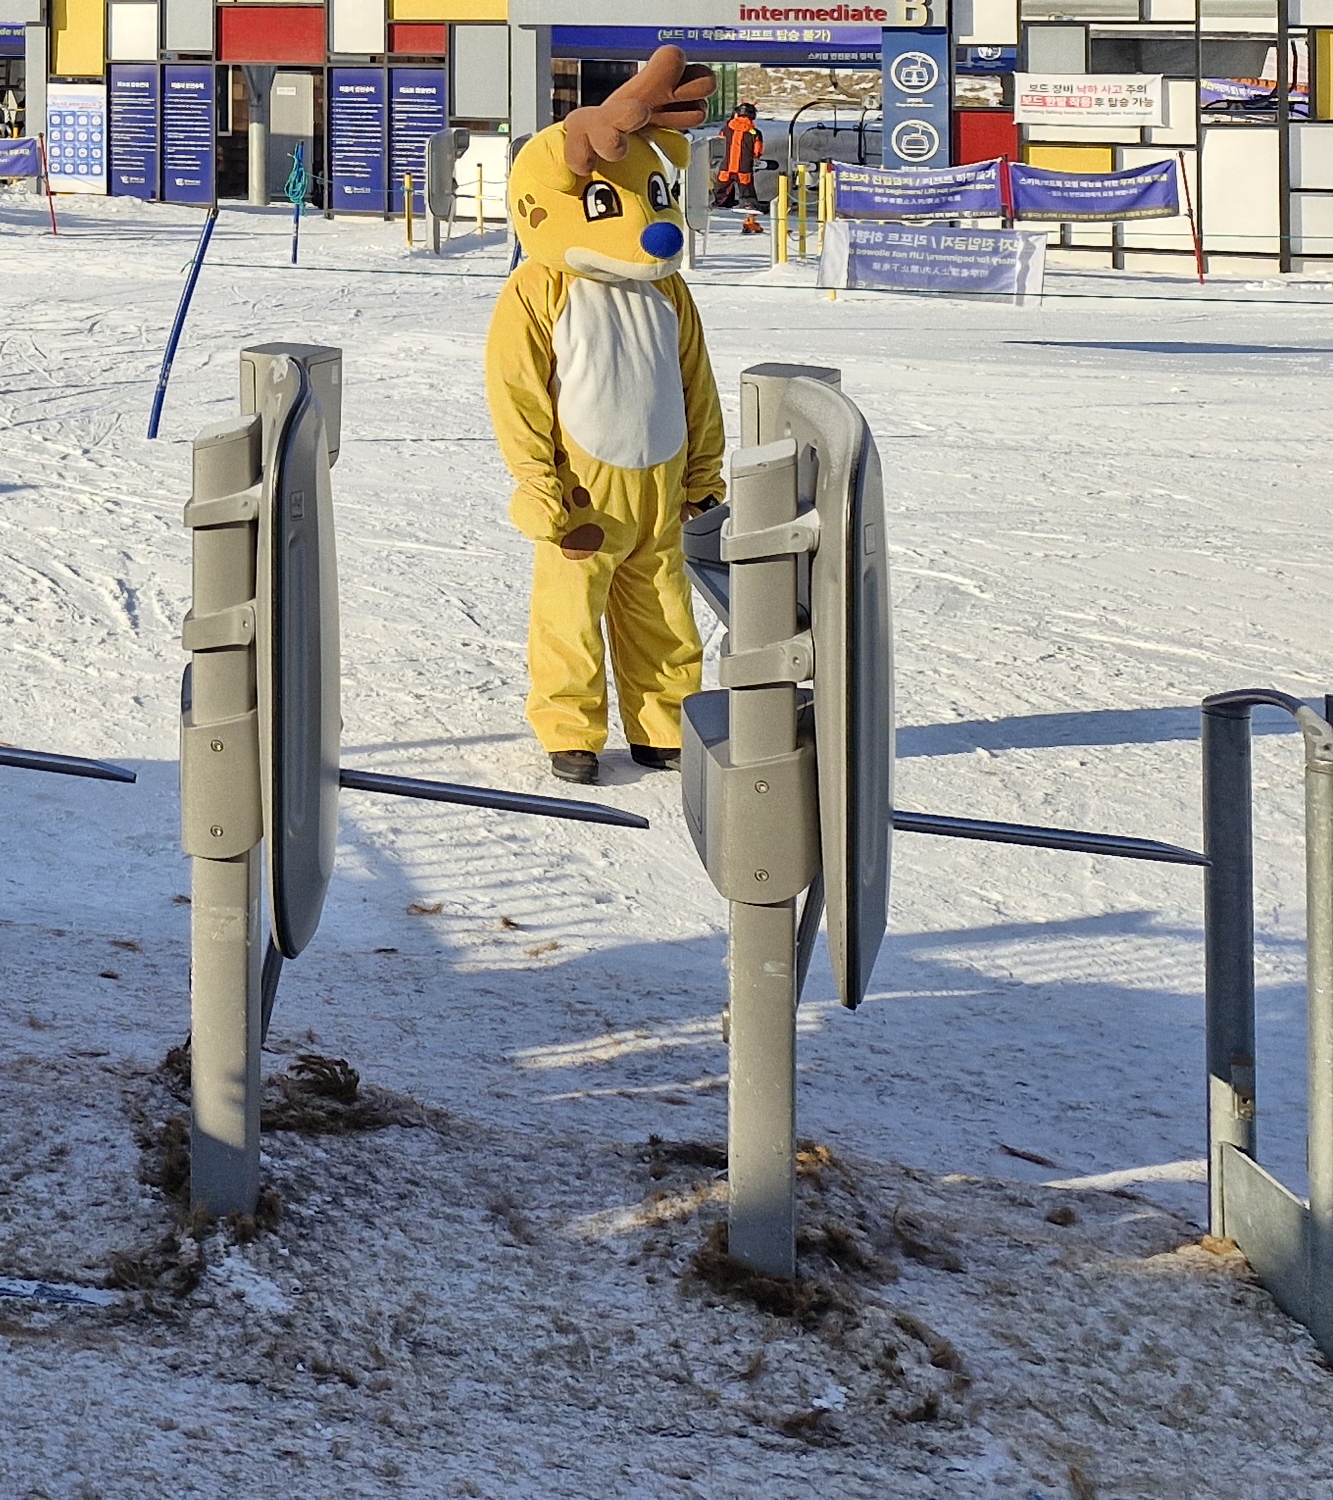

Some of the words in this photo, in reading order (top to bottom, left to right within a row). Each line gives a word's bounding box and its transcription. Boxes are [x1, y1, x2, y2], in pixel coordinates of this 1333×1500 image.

[740, 4, 887, 22] intermediate
[13, 28, 26, 36] wi
[738, 29, 774, 41] 리프트
[777, 29, 799, 41] 탑승
[1029, 83, 1050, 93] 보드
[1052, 84, 1074, 94] 장비
[1076, 84, 1098, 94] 낙하
[1100, 85, 1124, 94] 사고
[1125, 84, 1148, 94] 주의
[1108, 98, 1129, 107] 탑승
[1132, 97, 1154, 107] 가능
[839, 170, 870, 184] 초보자
[872, 174, 913, 186] 진입금지
[922, 175, 955, 186] 리프트
